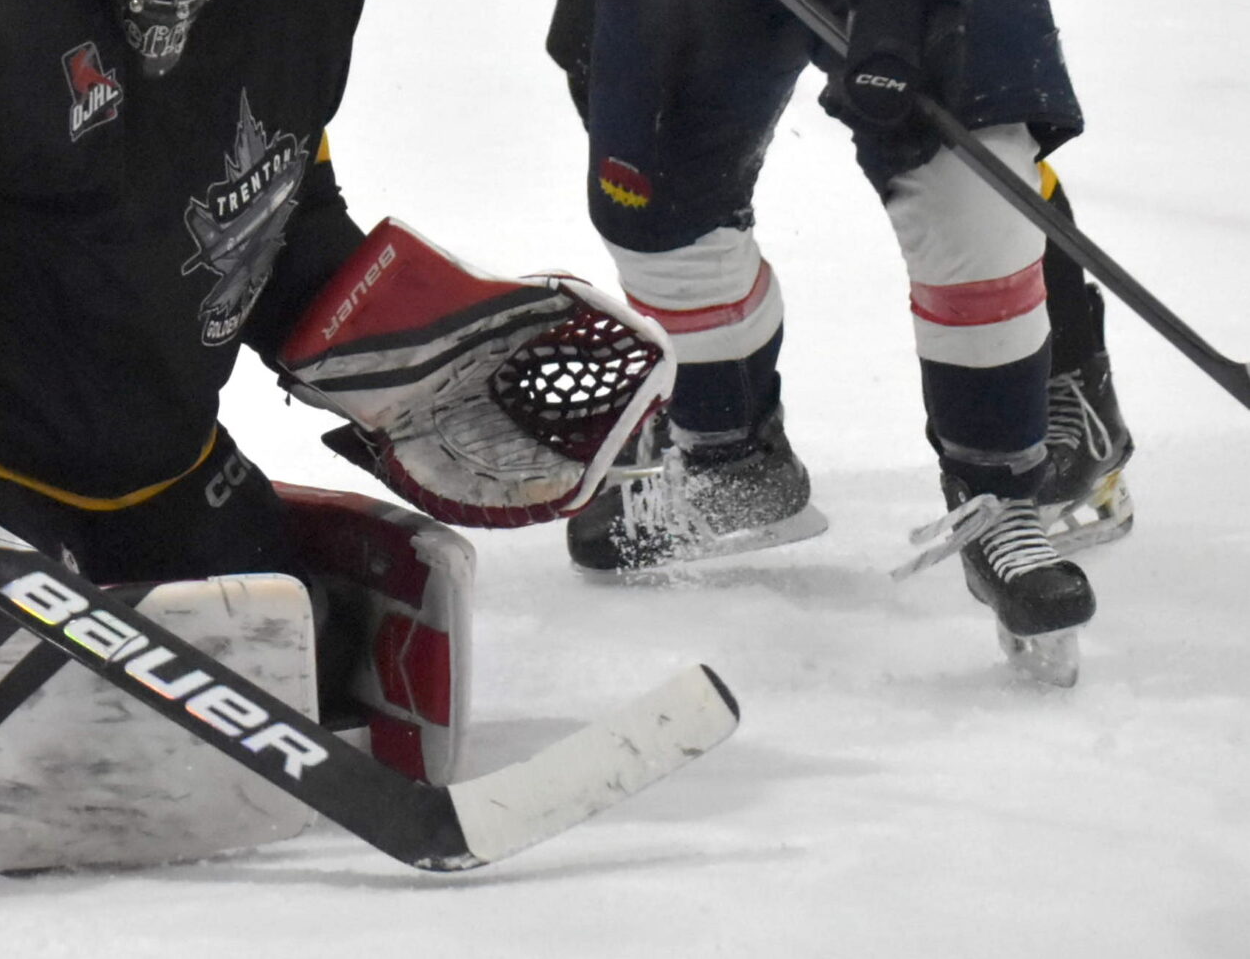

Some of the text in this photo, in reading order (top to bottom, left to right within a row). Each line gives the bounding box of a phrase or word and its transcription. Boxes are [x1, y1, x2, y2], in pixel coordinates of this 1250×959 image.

[72, 81, 119, 132] OJHL
[855, 73, 907, 92] CCM
[217, 147, 291, 217] TRENTON
[321, 243, 397, 342] BAUER
[205, 449, 253, 509] CC
